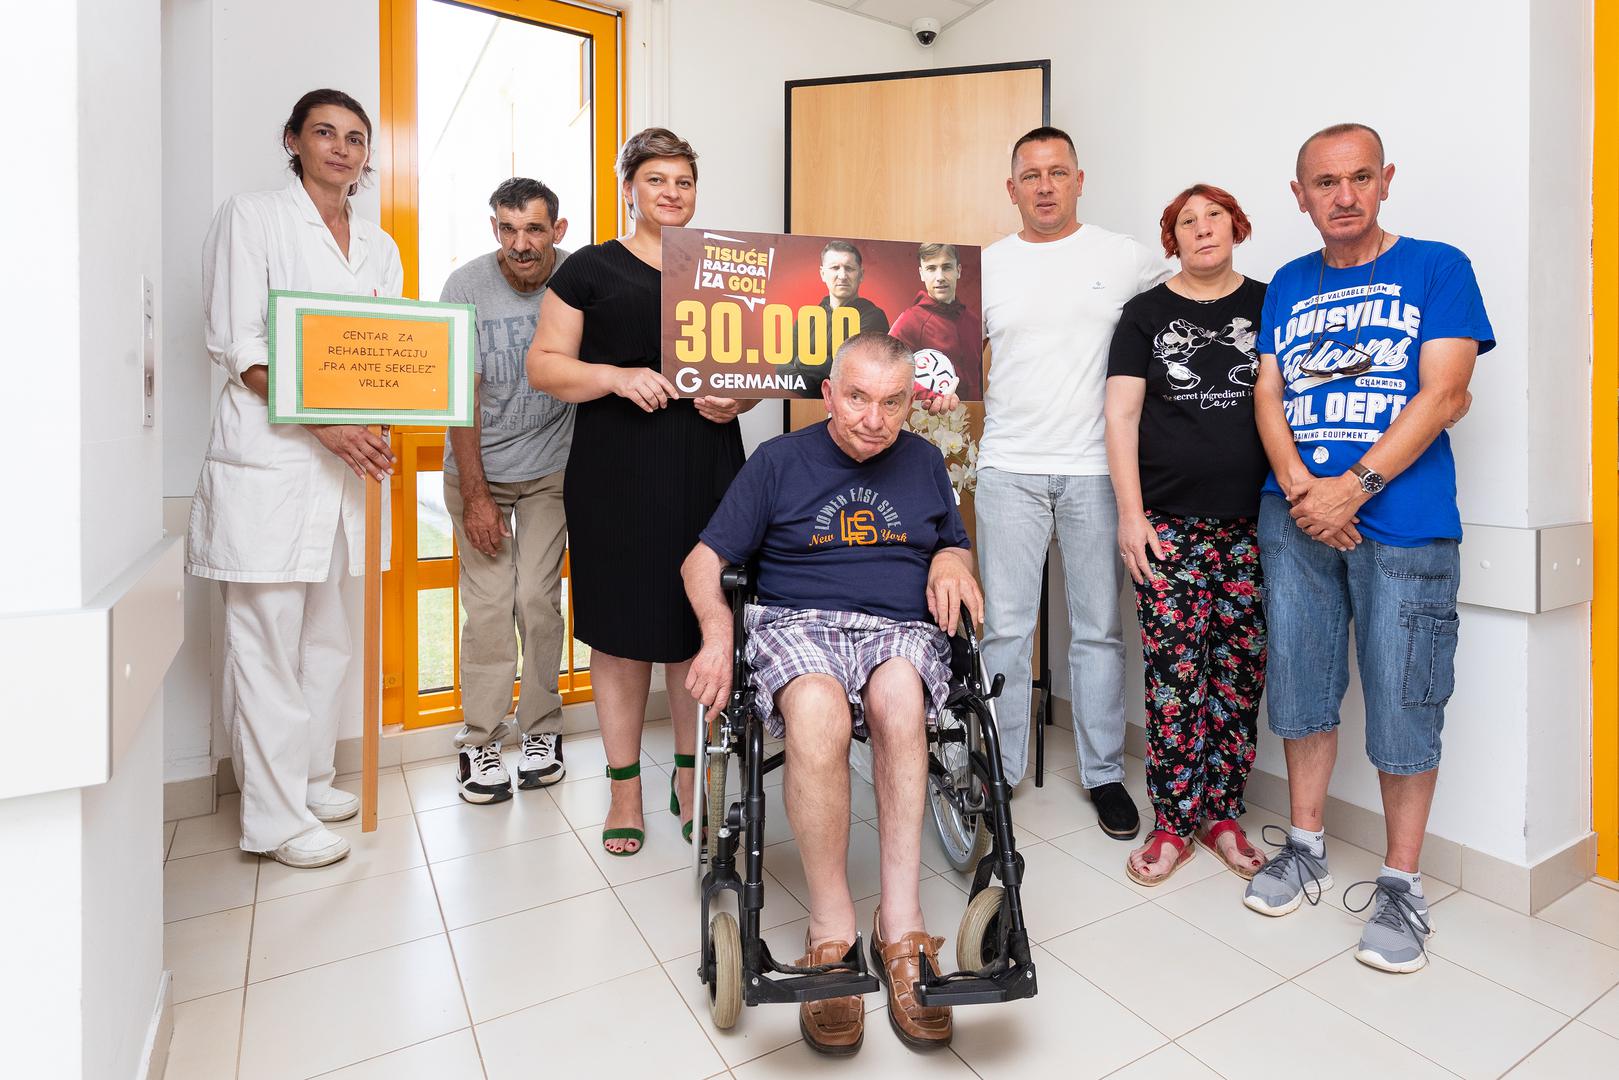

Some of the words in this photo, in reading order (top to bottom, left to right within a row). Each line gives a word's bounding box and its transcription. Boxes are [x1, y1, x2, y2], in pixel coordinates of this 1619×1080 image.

[704, 244, 768, 266] TISUĆE
[702, 259, 767, 277] RAZLOGA
[701, 271, 724, 289] ZA
[728, 275, 766, 295] GOL!
[1327, 287, 1365, 299] VALUABLE
[1368, 285, 1388, 293] TEAM
[342, 330, 389, 341] CENTAR
[398, 333, 414, 342] ZA
[675, 299, 861, 366] 30.000
[1273, 299, 1421, 355] LOUISVILLE
[328, 346, 428, 358] REHABILITACIJU
[350, 362, 381, 373] ANTE
[358, 379, 399, 388] VRLIKA
[709, 373, 807, 391] GERMANIA
[1359, 378, 1403, 388] CHAMPIONS
[1173, 392, 1198, 400] secret
[1200, 389, 1246, 401] ingredient
[1200, 385, 1238, 409] Love
[1323, 431, 1369, 440] EQUIPMENT
[814, 494, 849, 531] LOWER
[849, 487, 879, 506] EAST
[877, 500, 902, 528] SIDE
[808, 533, 835, 547] New
[880, 529, 908, 544] York
